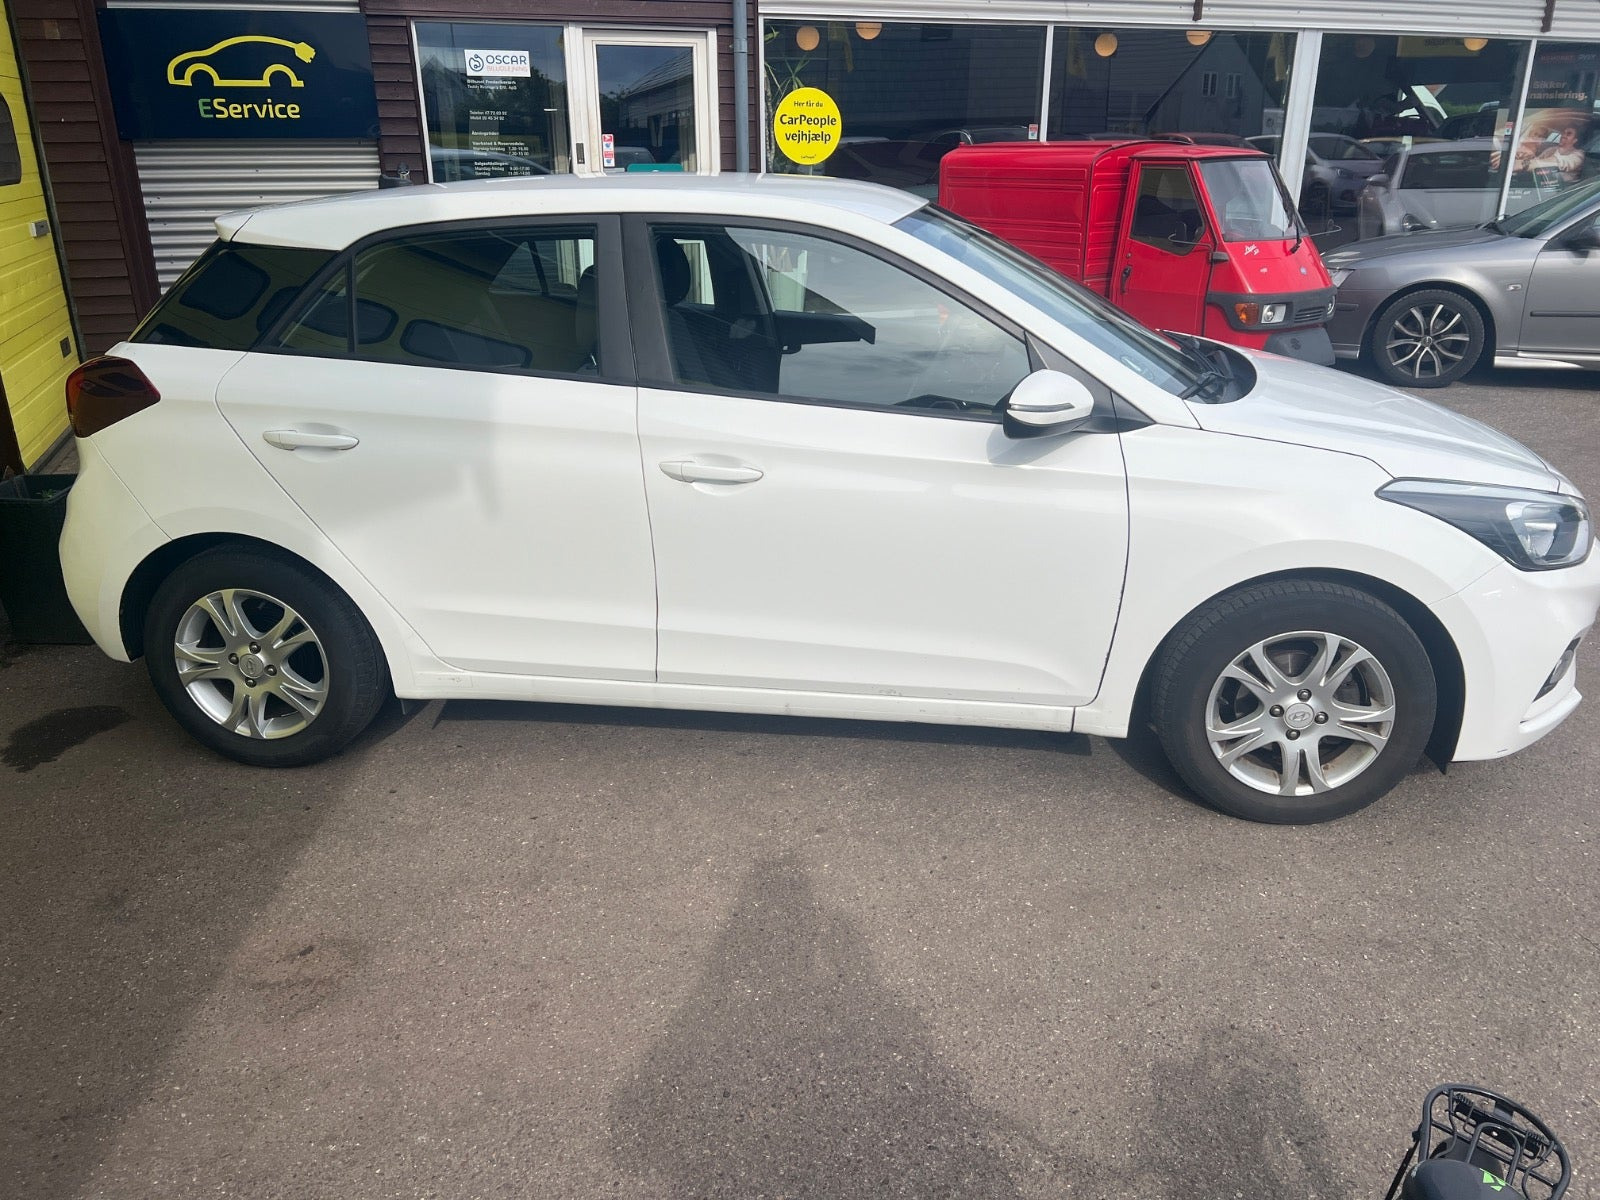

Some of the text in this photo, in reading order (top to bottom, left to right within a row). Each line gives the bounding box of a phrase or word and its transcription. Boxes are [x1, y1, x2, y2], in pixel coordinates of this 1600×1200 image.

[486, 55, 527, 65] OSCAR
[1533, 81, 1568, 90] Sikker
[198, 98, 301, 119] EService
[779, 113, 837, 128] CarPeople
[785, 130, 831, 144] vejhjælp
